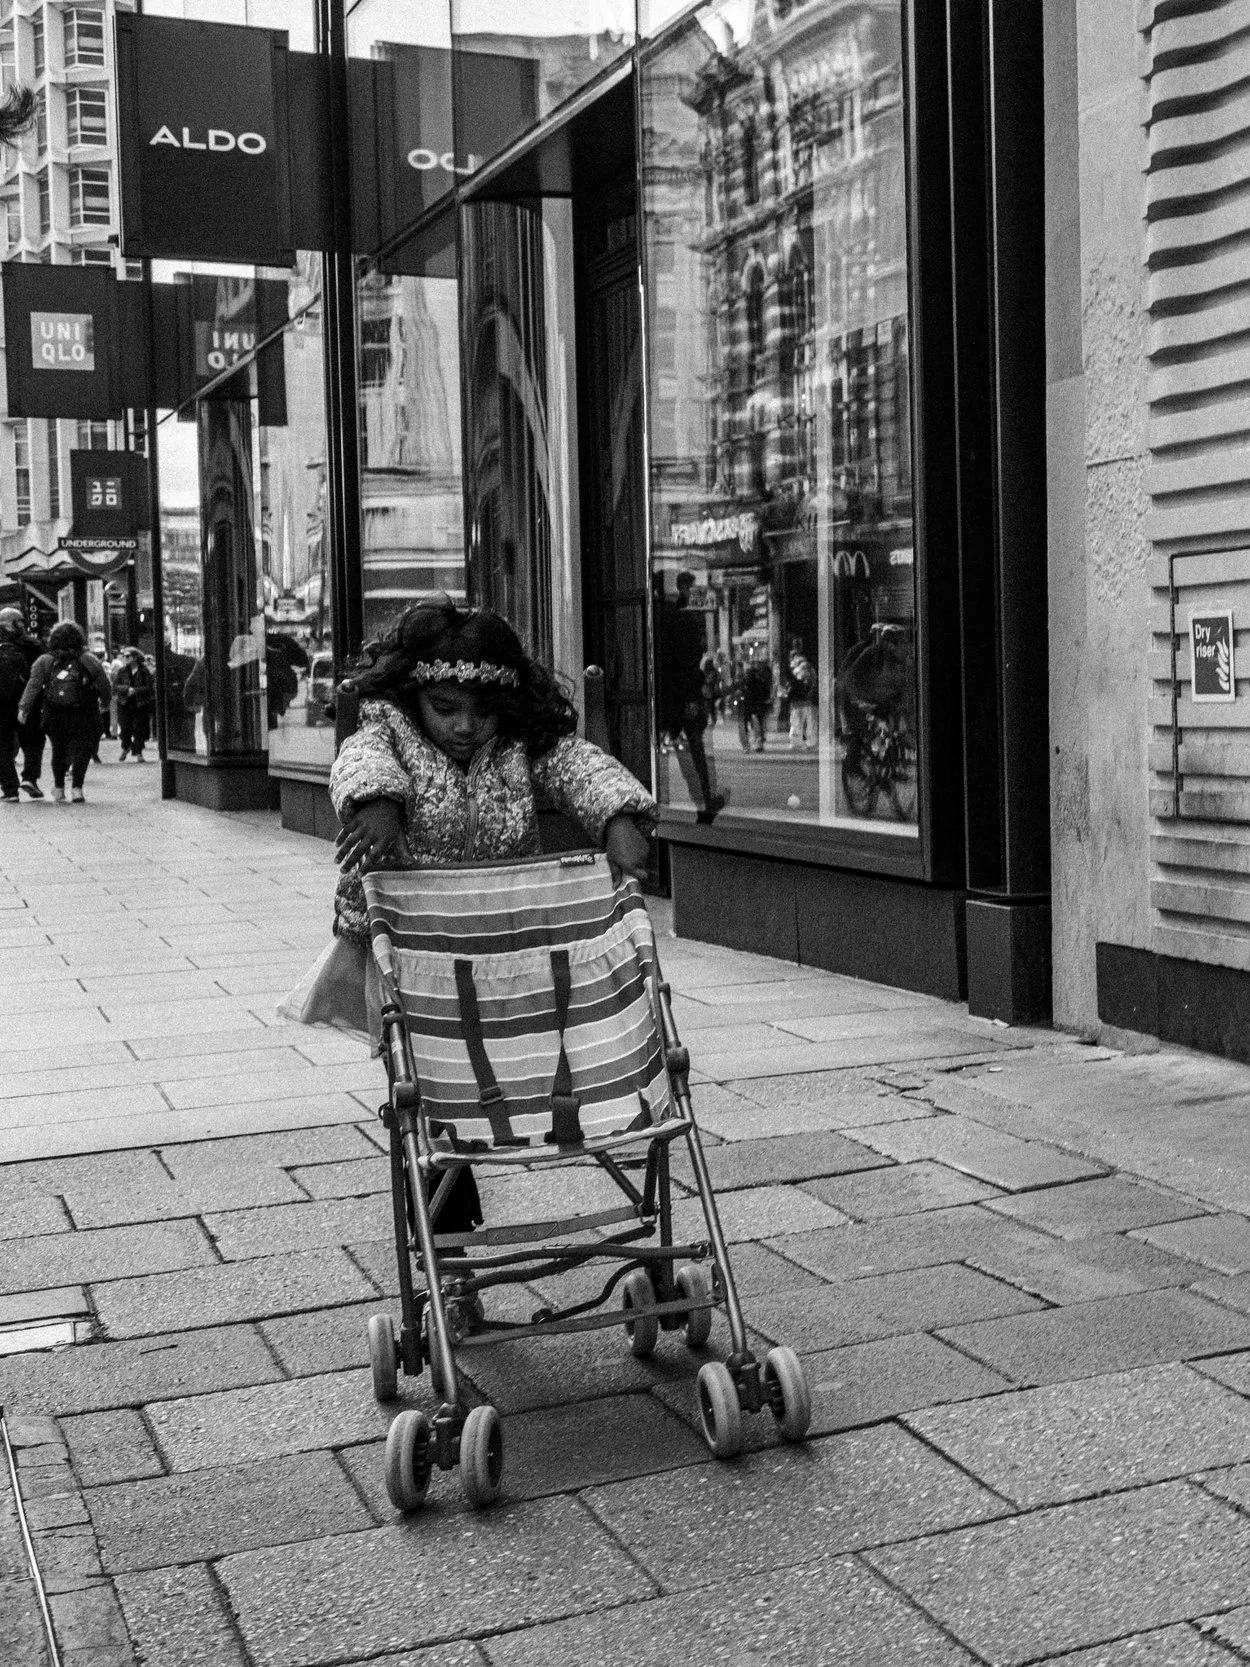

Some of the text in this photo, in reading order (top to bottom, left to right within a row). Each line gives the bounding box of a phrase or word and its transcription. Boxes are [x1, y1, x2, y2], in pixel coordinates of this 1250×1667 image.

[148, 124, 267, 155] ALDO
[40, 320, 81, 342] UNI
[41, 343, 86, 365] QLO
[61, 539, 137, 548] UNDERGROUND
[1195, 624, 1211, 642] Dry
[1196, 643, 1217, 658] riser
